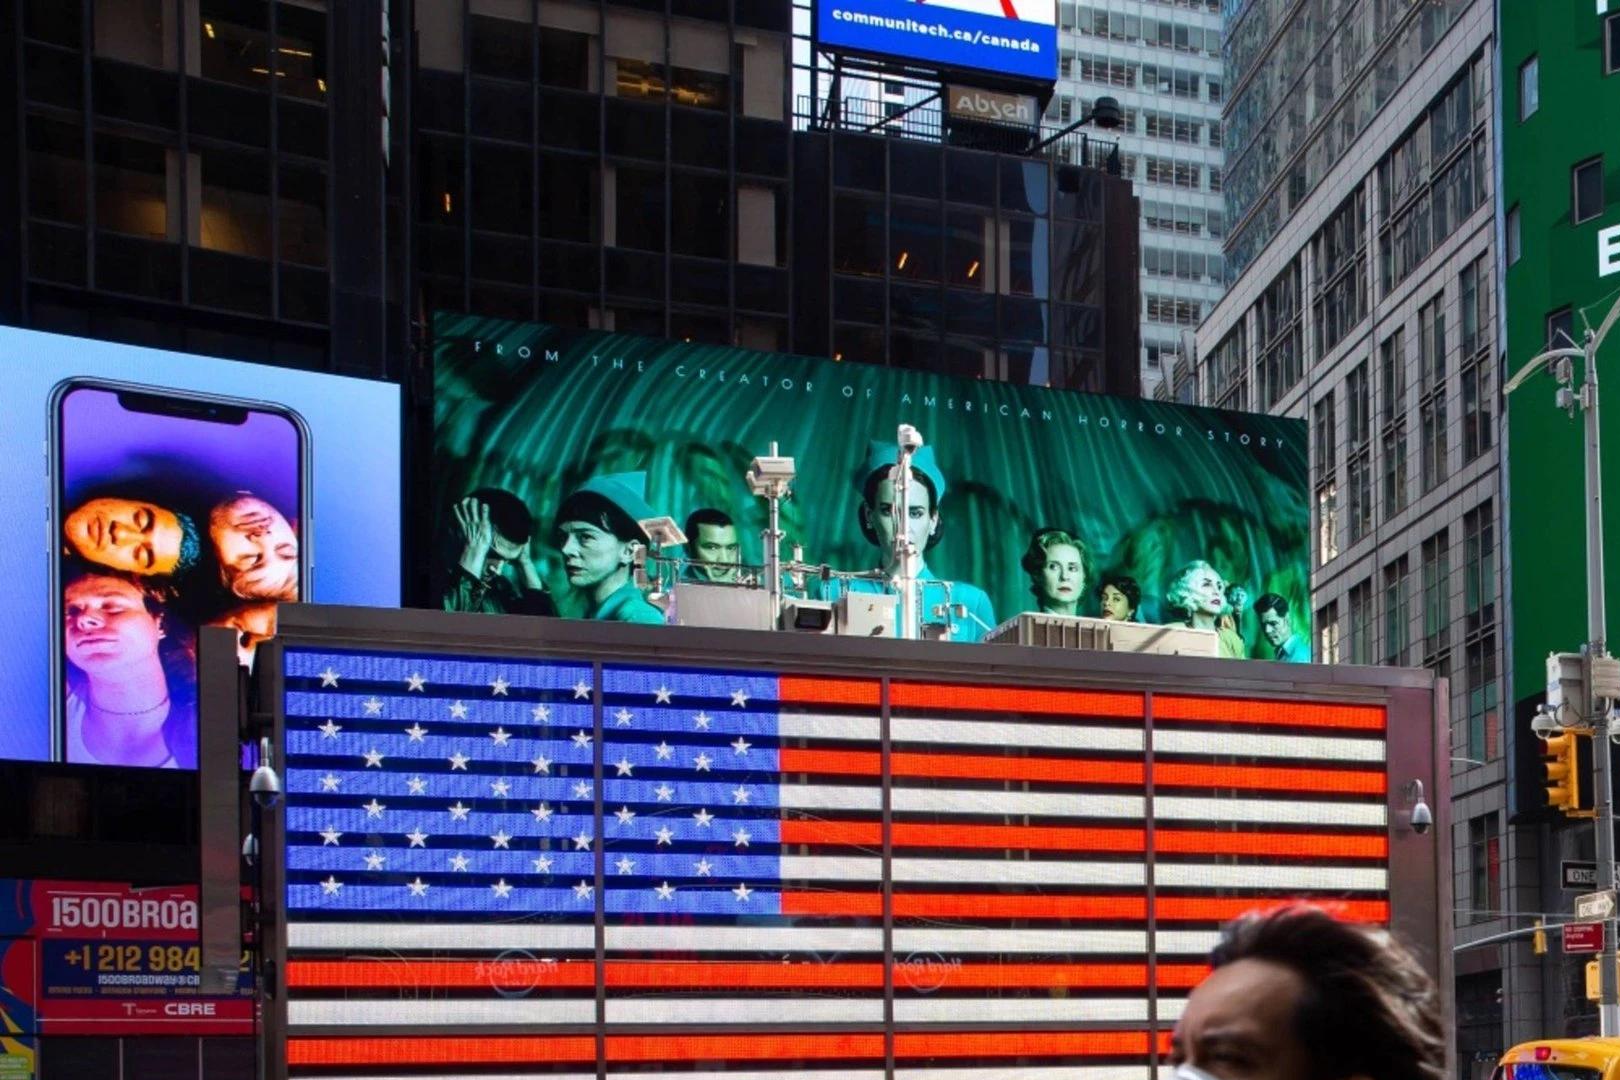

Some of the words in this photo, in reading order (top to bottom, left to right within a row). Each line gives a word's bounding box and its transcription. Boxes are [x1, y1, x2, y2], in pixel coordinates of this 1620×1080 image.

[832, 8, 1040, 53] communitech.ca/canada
[956, 94, 1029, 119] Absen
[475, 341, 559, 362] FROM
[592, 355, 644, 373] THE
[676, 365, 813, 392] CREATOR
[842, 385, 872, 399] OF
[901, 393, 1053, 421] AMERICAN
[1079, 415, 1183, 437] HORROR
[1208, 430, 1285, 448] STORY
[64, 944, 91, 971] +1
[98, 944, 142, 972] 212
[148, 944, 201, 972] 984
[164, 1003, 216, 1015] CBRE
